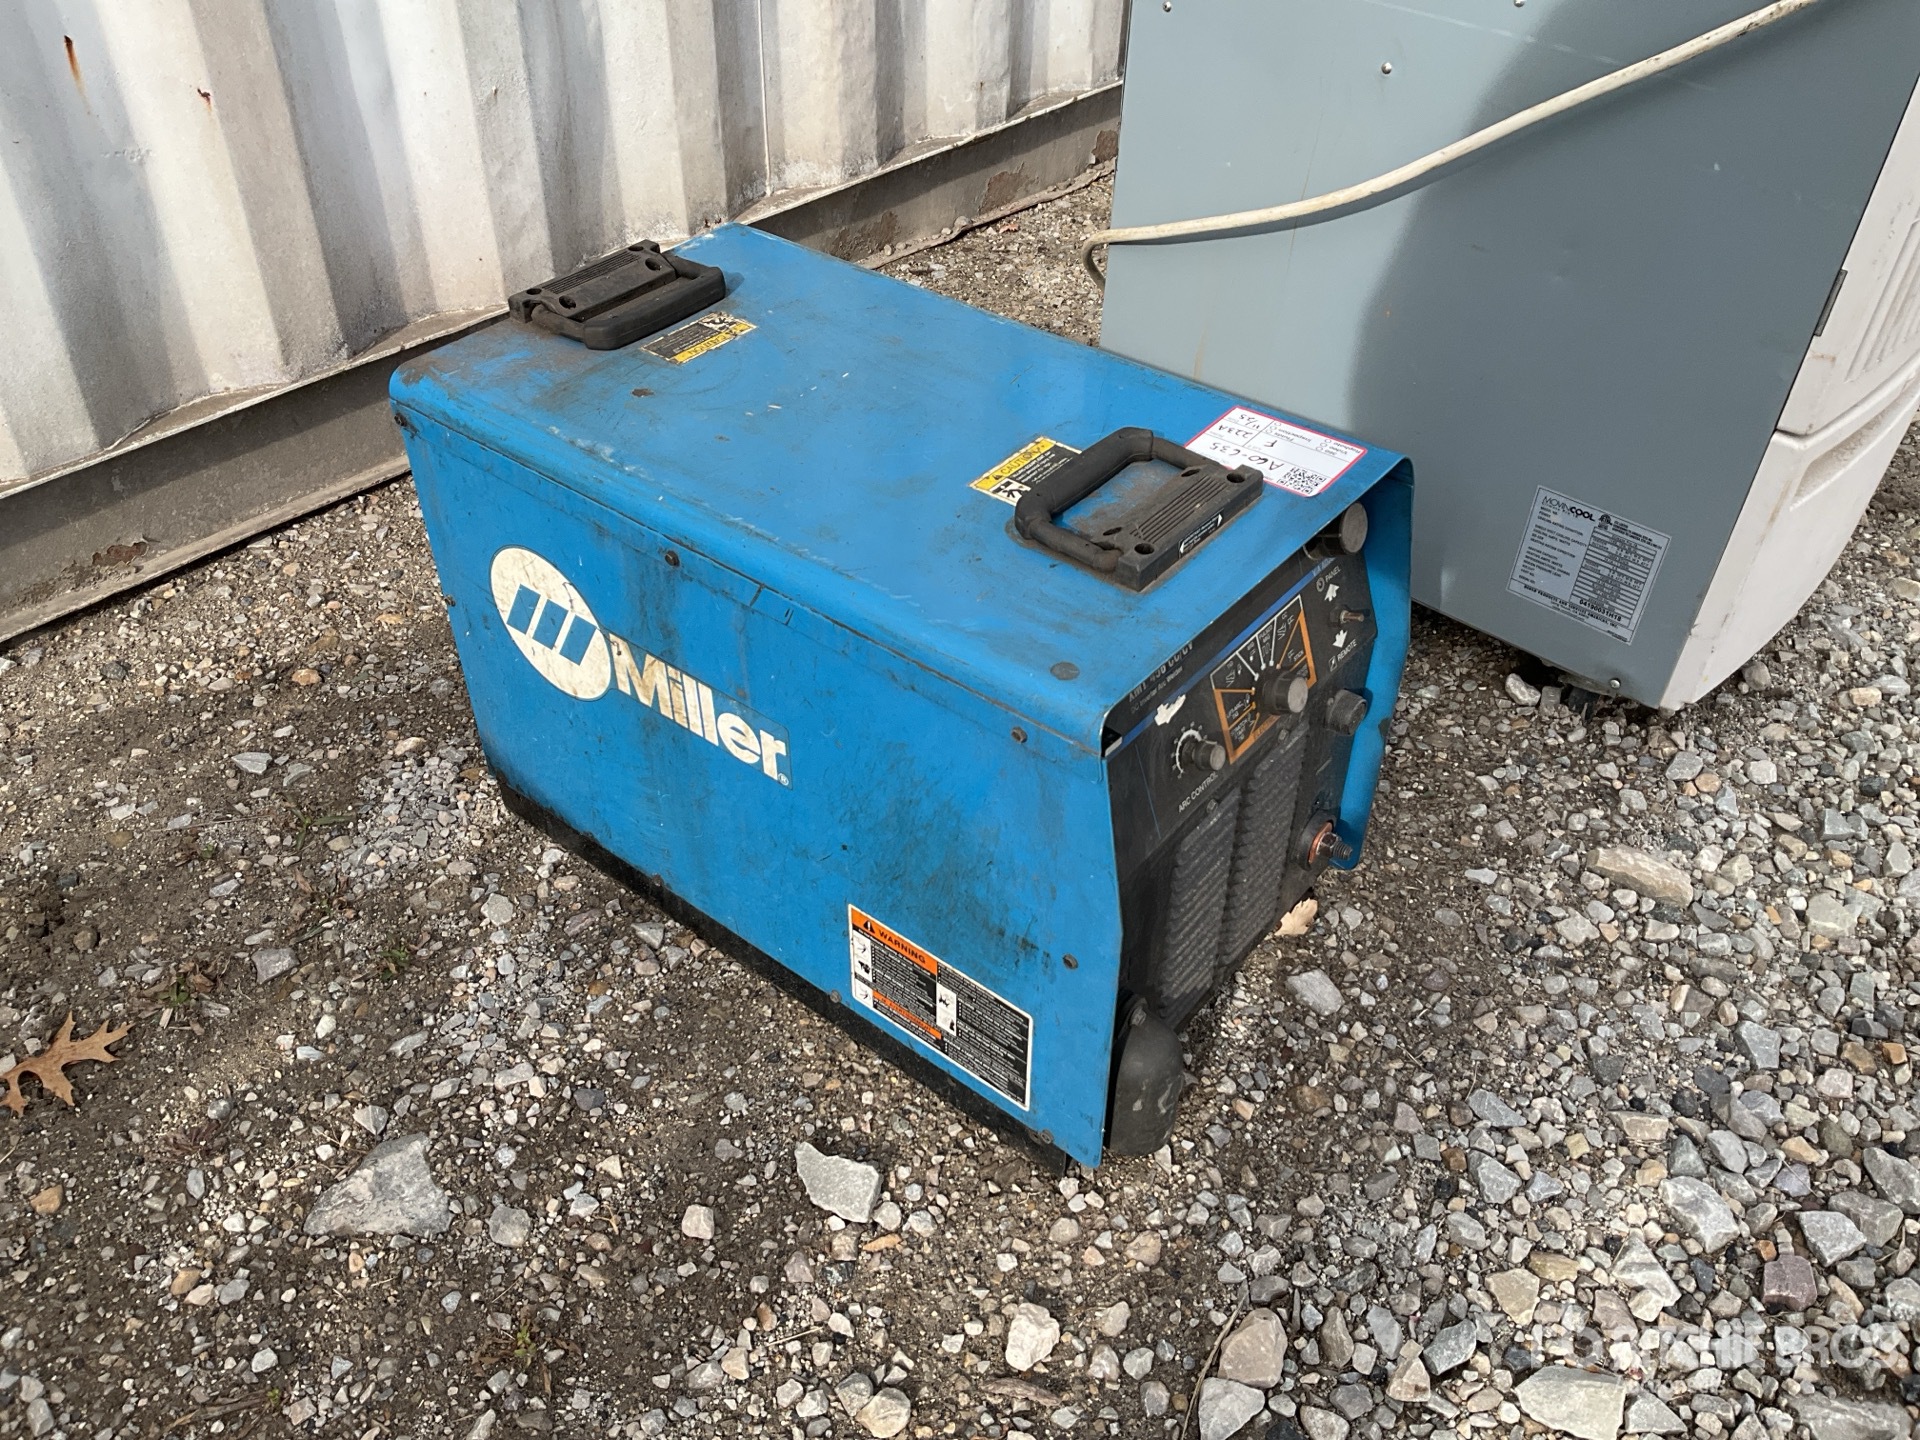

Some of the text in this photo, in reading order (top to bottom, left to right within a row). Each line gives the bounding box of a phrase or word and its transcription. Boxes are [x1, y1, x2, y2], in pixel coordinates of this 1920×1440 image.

[1218, 424, 1254, 439] 223A
[1278, 428, 1311, 443] Inspection
[1000, 447, 1040, 475] CAUTION
[1325, 565, 1341, 583] PANEL
[1337, 638, 1358, 661] REMOTE
[607, 632, 787, 781] Miller
[1178, 771, 1219, 813] ARC CONTROL
[878, 929, 926, 965] WARNING
